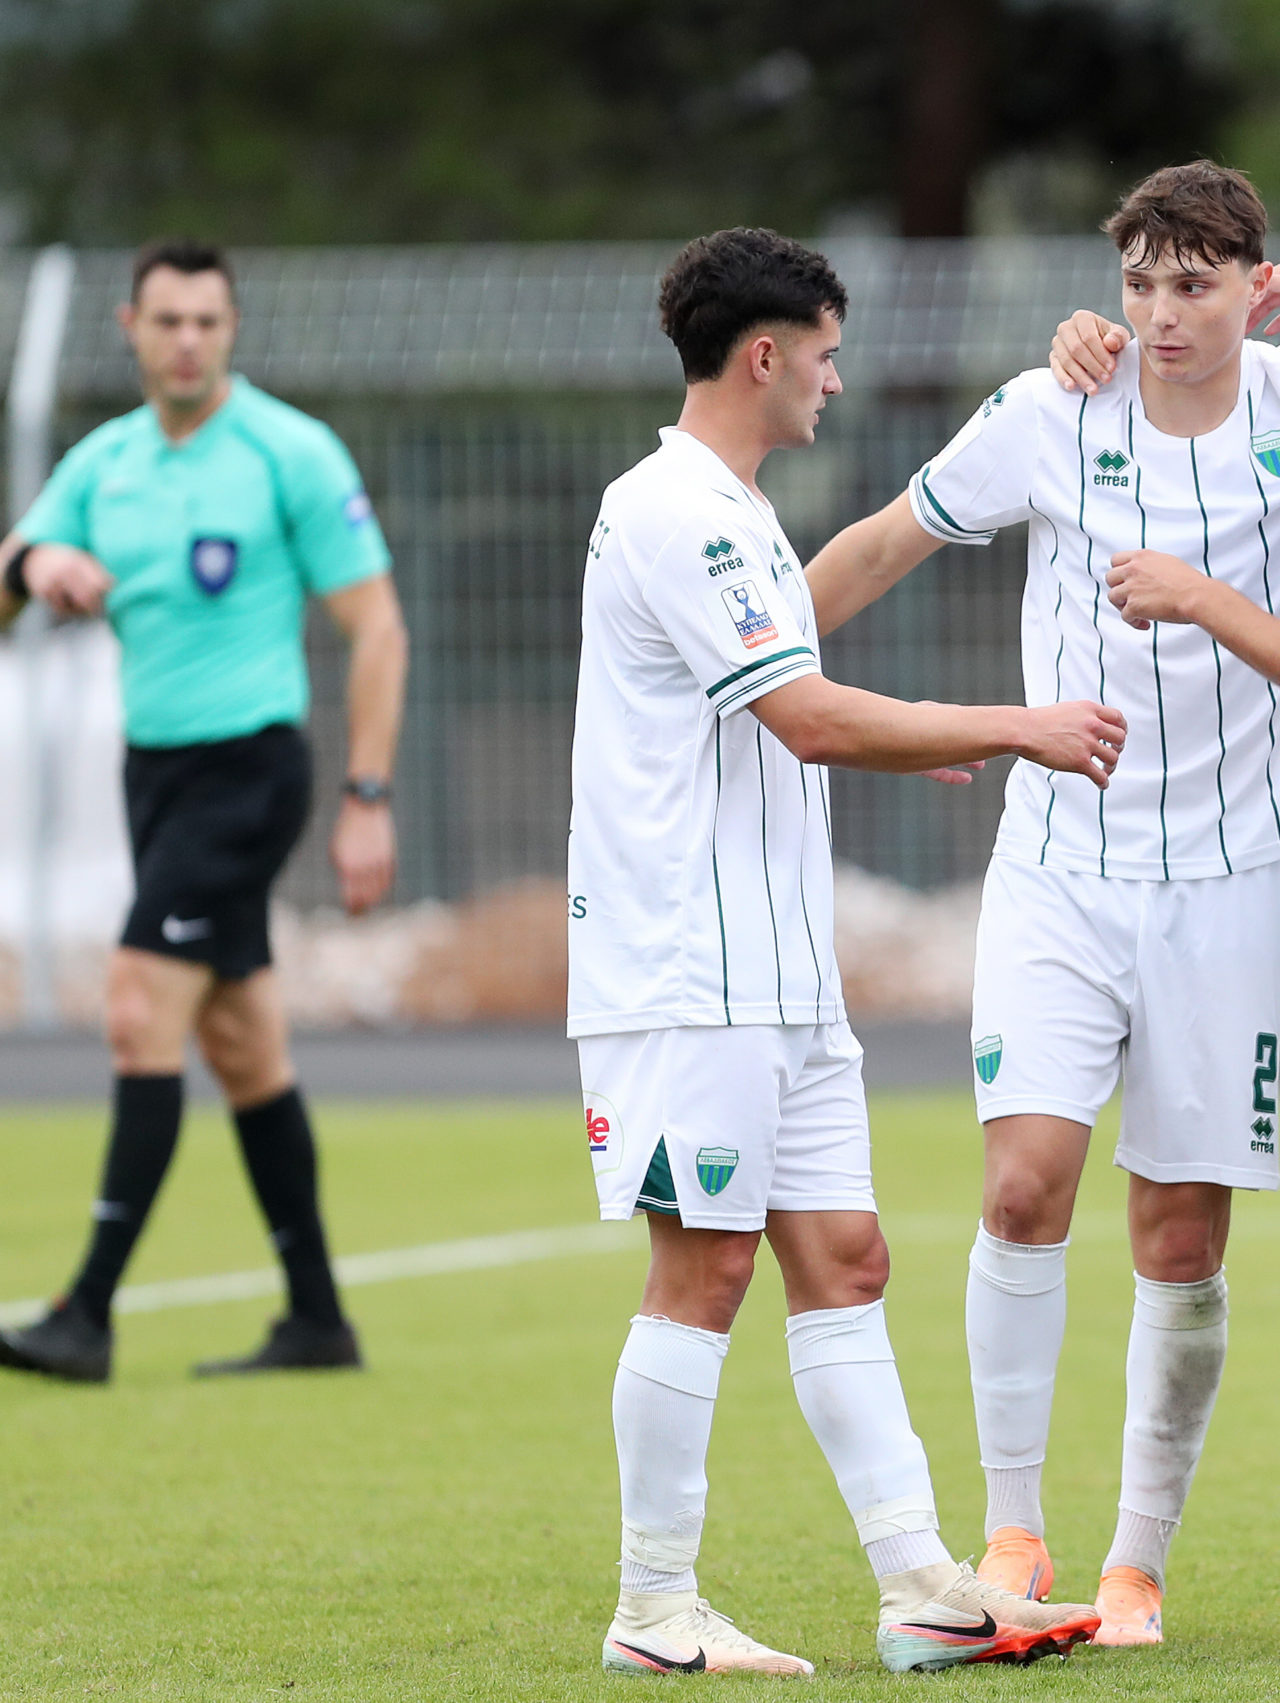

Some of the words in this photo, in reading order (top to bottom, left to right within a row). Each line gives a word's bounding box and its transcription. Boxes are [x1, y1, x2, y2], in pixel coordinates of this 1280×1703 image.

[1094, 473, 1129, 487] errea
[708, 556, 744, 577] errea
[743, 629, 777, 646] betsson
[1252, 1031, 1278, 1114] 2
[1250, 1140, 1274, 1155] errea
